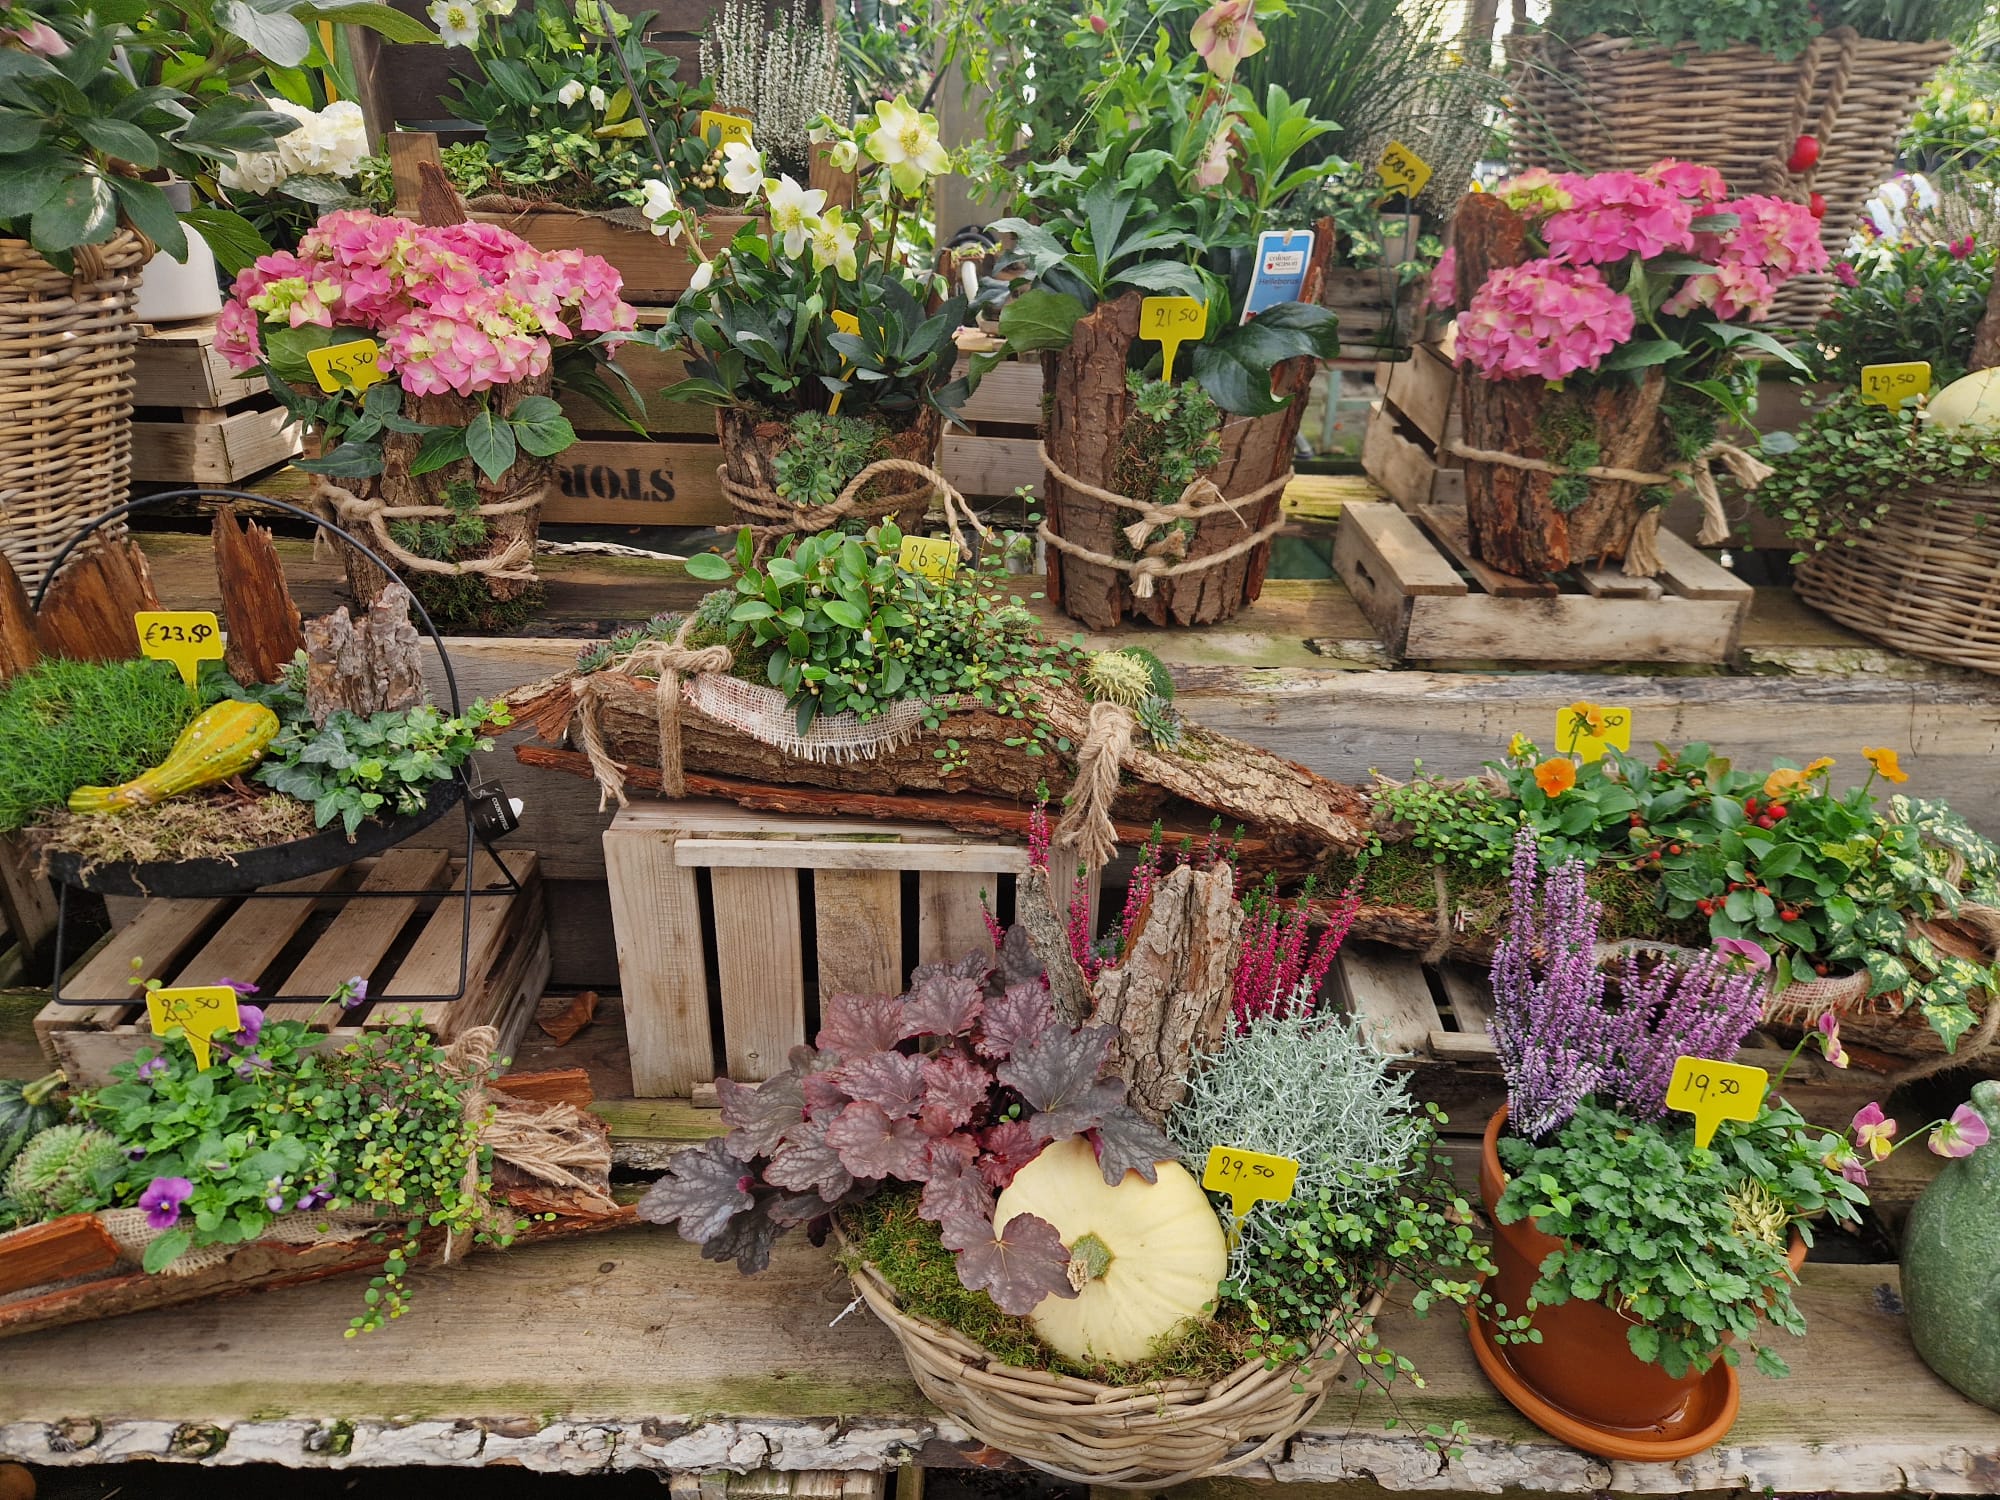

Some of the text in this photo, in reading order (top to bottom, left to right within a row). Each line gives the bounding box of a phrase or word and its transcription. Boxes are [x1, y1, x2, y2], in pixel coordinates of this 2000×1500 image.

[143, 622, 213, 648] €23,50
[1684, 1072, 1740, 1103] 19.50
[1219, 1156, 1275, 1183] 29.50
